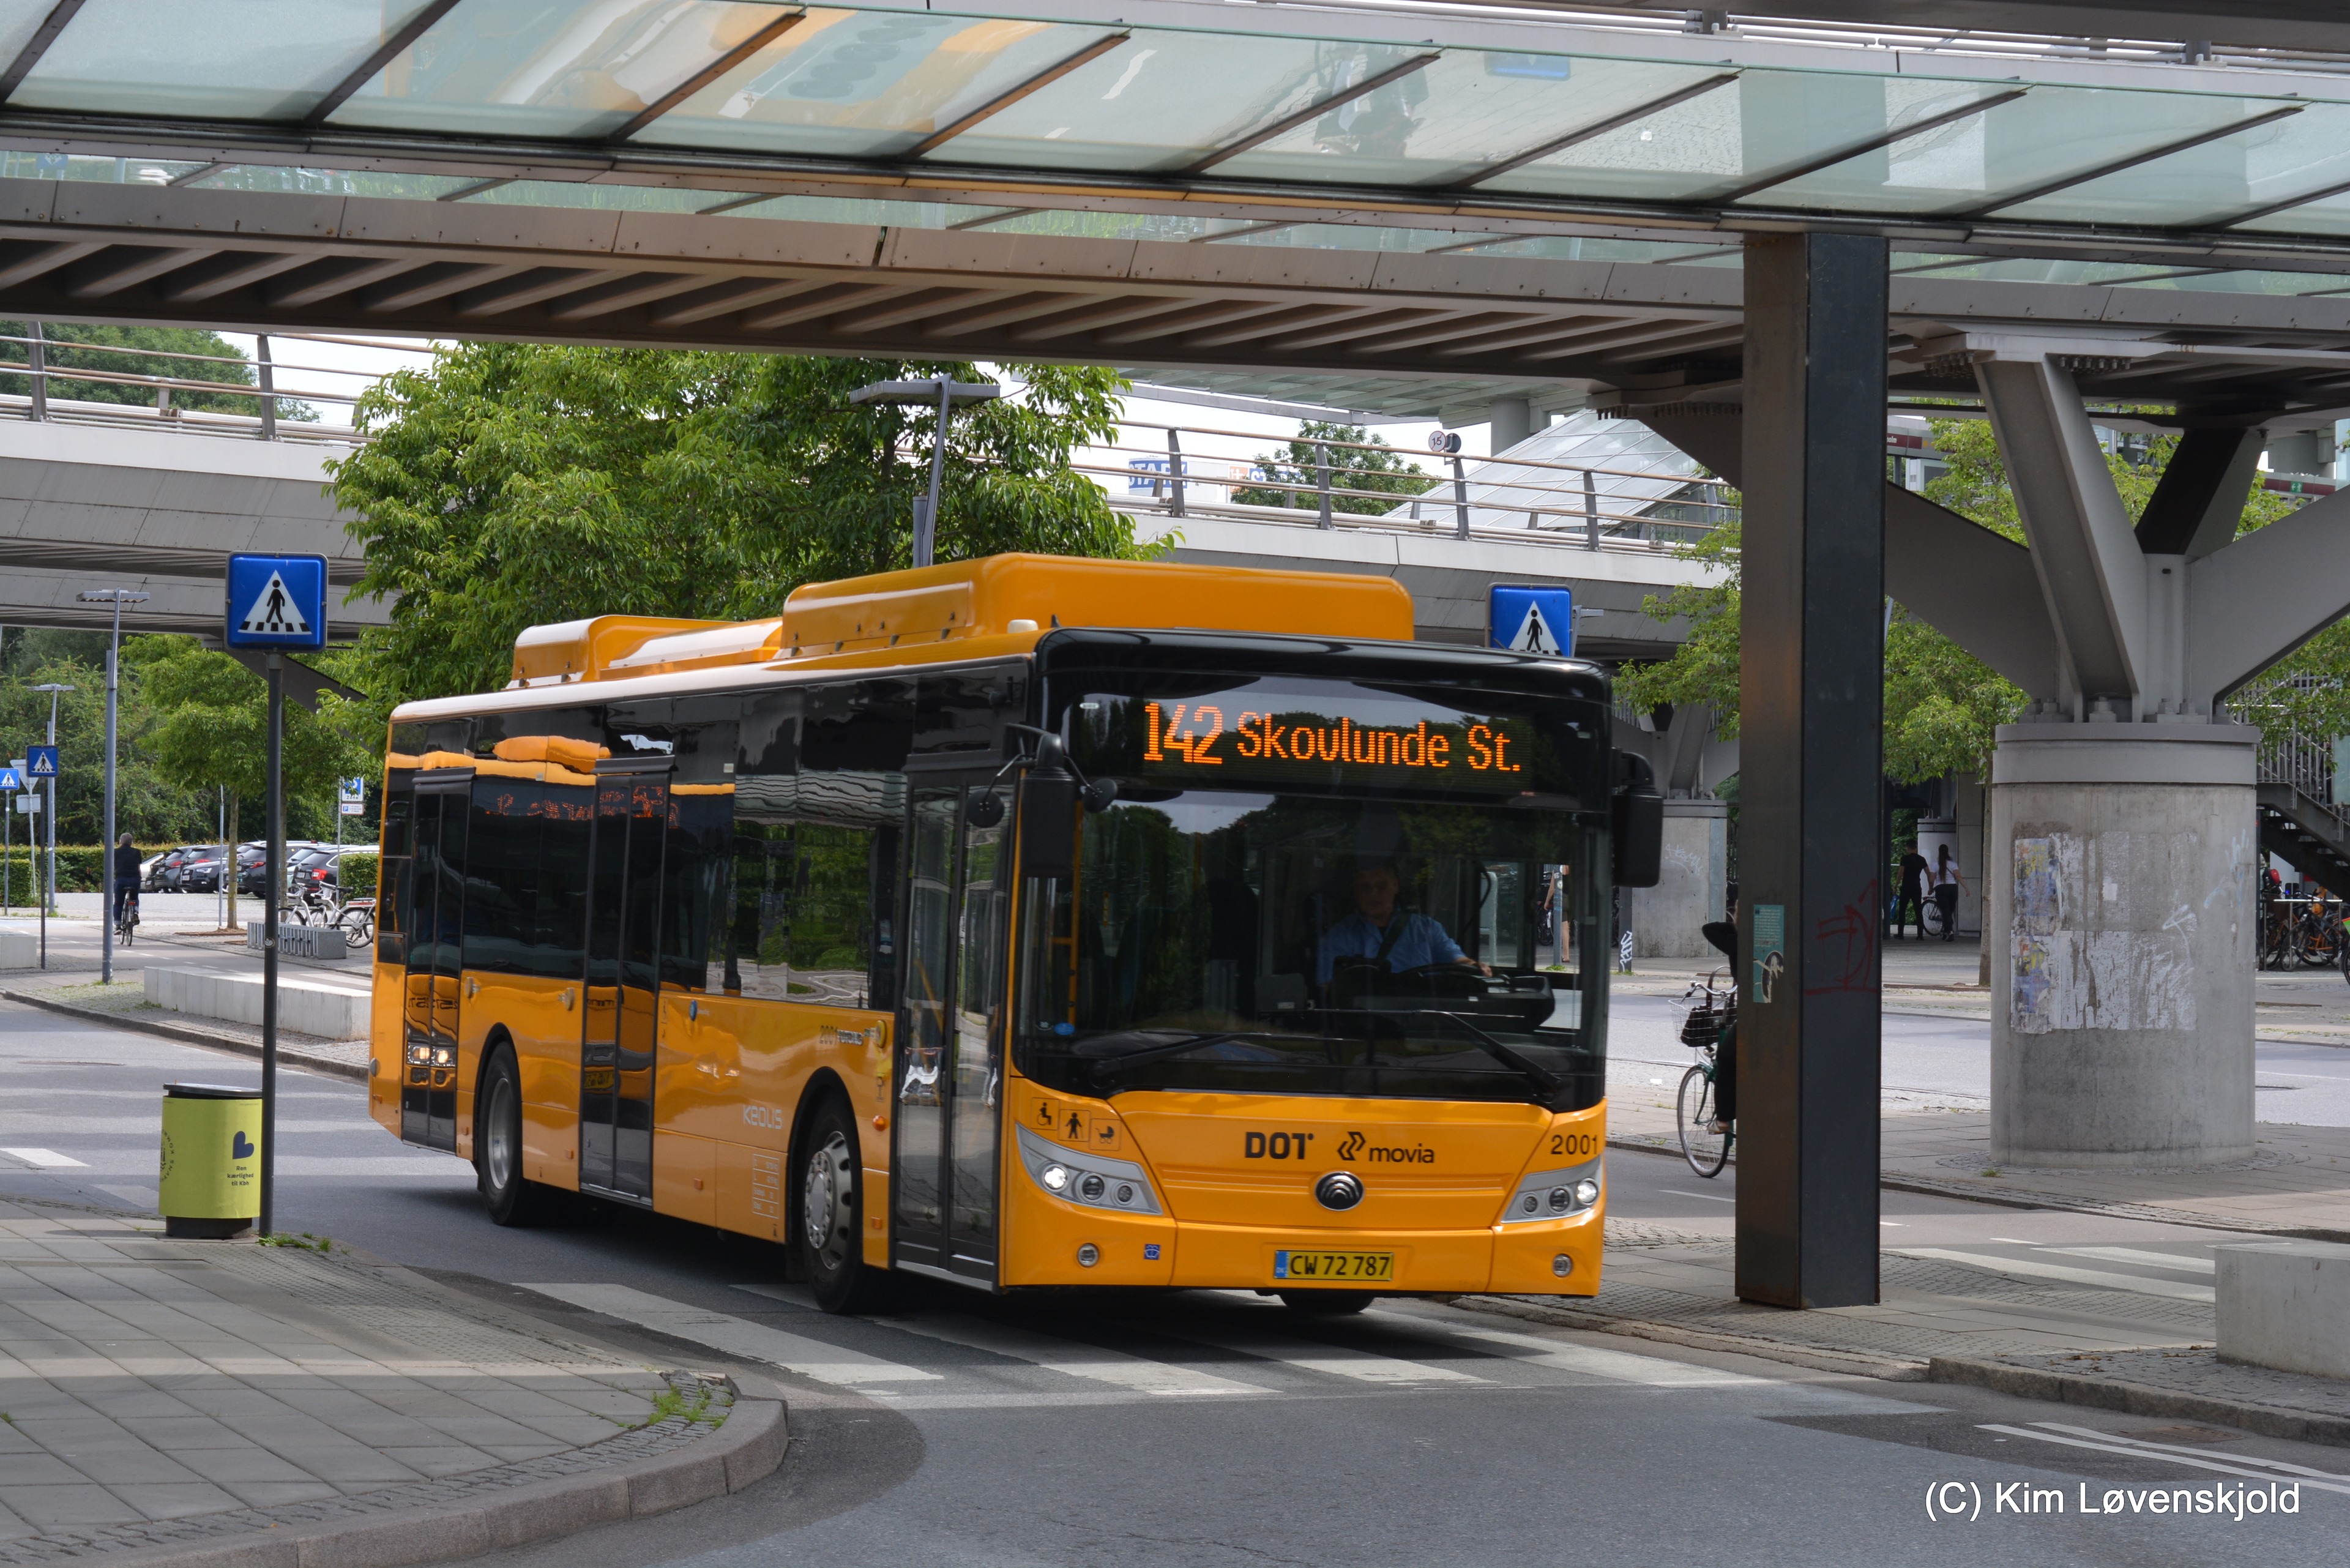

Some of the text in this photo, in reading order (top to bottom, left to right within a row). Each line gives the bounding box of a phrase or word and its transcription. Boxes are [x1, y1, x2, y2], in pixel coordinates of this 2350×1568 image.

[1431, 437, 1442, 446] 15
[1143, 702, 1521, 772] 142 Skovlunde St.
[1245, 1131, 1314, 1160] DOT
[1368, 1143, 1434, 1163] movia
[1550, 1133, 1598, 1155] 2001
[1290, 1255, 1390, 1276] CW 72 787
